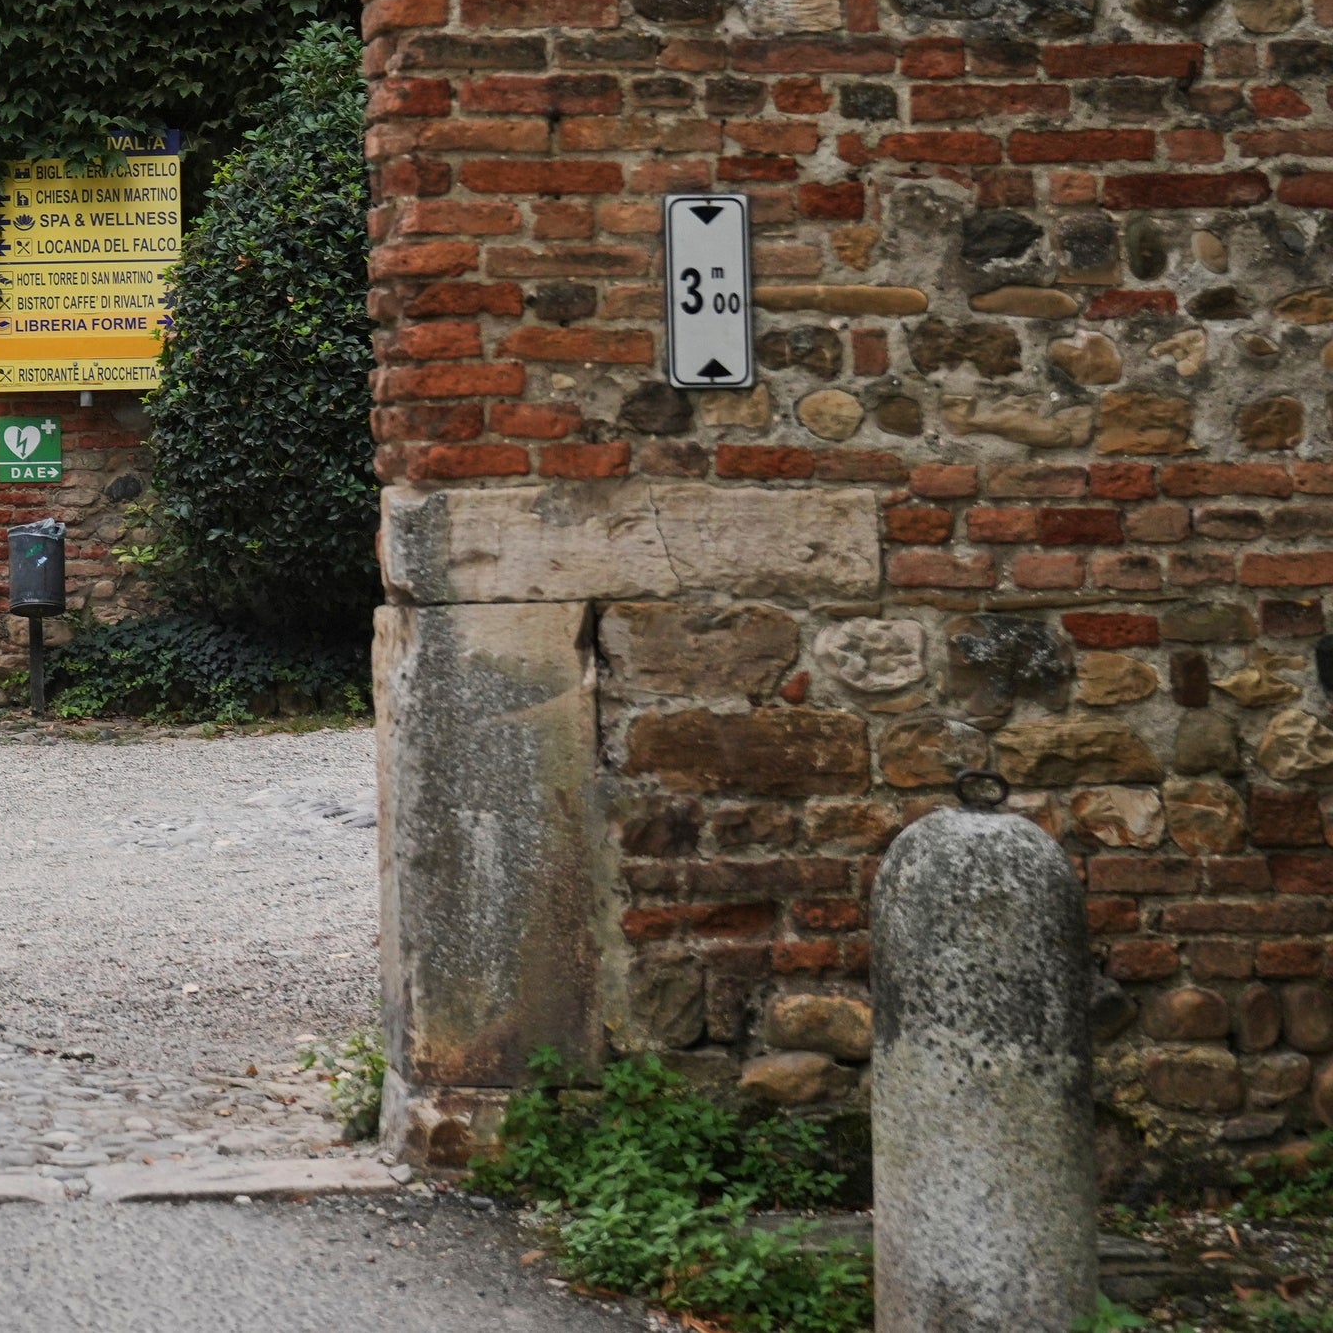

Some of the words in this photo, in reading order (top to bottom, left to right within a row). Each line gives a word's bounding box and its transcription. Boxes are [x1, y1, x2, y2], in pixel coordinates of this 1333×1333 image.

[117, 162, 177, 178] CASTELLO
[36, 189, 79, 204] CHIESA
[82, 188, 94, 203] DI
[97, 188, 121, 203] SAN
[124, 186, 178, 202] MARTINO
[40, 213, 70, 228] SPA
[75, 213, 86, 227] &
[90, 211, 178, 227] WELLNESS
[37, 238, 101, 254] LOCANDA
[104, 238, 129, 253] DEL
[133, 237, 177, 252] FALCO
[16, 272, 46, 286] HOTEL
[48, 272, 78, 286] TORRE
[80, 271, 90, 285] DI
[91, 271, 110, 285] SAN
[112, 270, 153, 284] MARTINO
[711, 267, 724, 279] m
[680, 267, 703, 315] 3
[17, 297, 60, 310] BISTROT
[63, 296, 99, 310] CAFFE'
[101, 295, 111, 309] DI
[114, 295, 155, 308] RIVALTA
[15, 319, 87, 332] LIBRERIA
[91, 318, 147, 331] FORME
[18, 367, 80, 382] RISTORANTE
[82, 367, 95, 381] LA
[97, 366, 157, 381] ROCCHETTA
[11, 467, 46, 479] DAE
